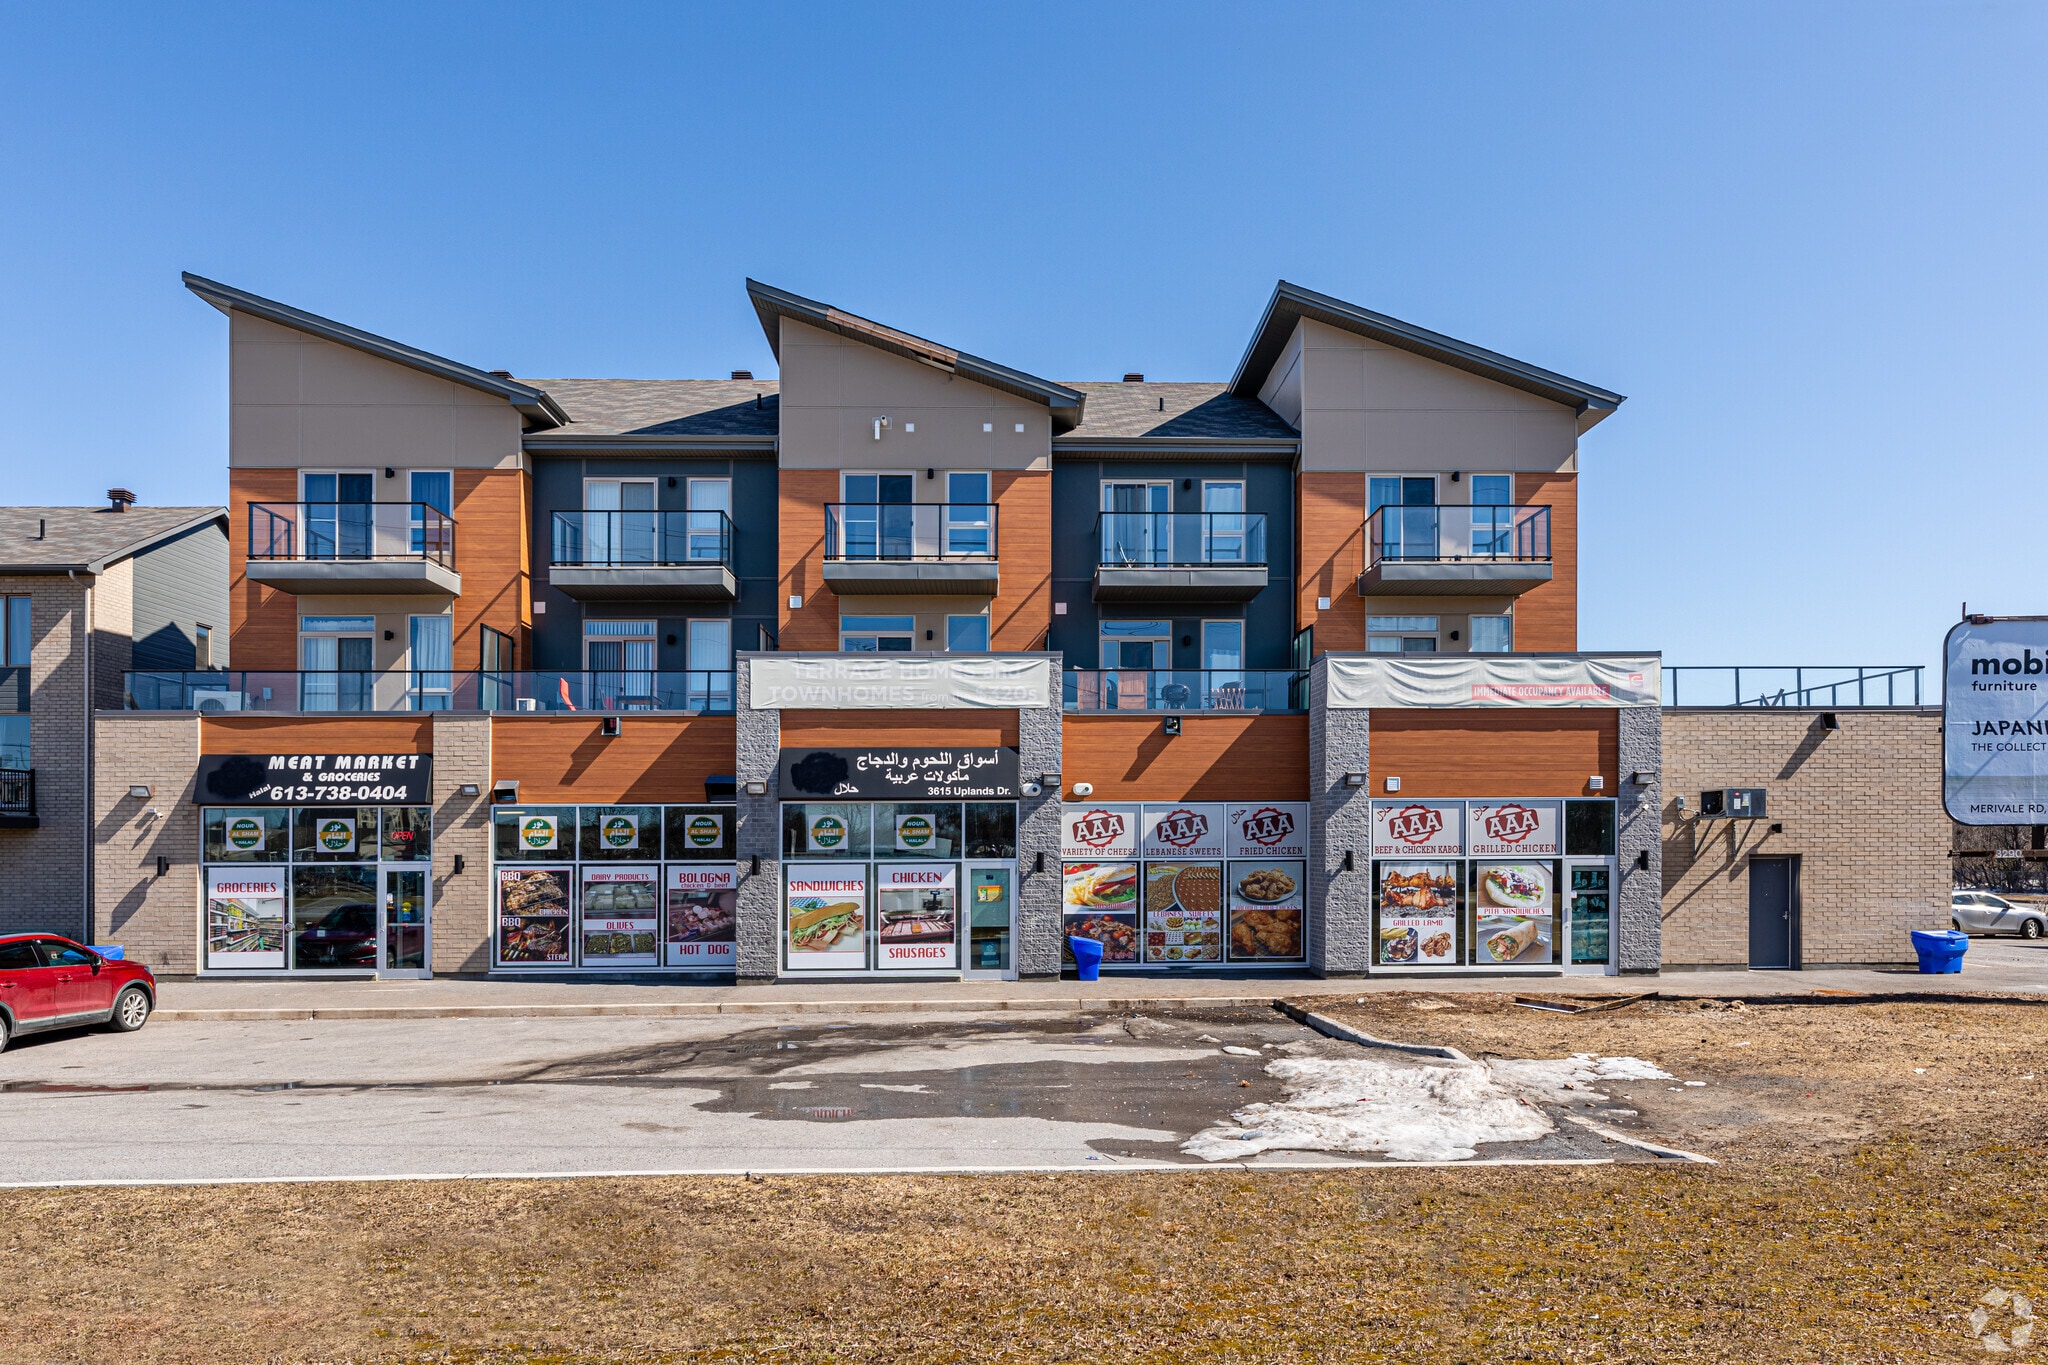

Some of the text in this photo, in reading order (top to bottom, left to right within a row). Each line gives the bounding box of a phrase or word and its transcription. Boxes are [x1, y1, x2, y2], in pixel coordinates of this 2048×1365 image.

[794, 664, 892, 680] TERRACE
[1474, 686, 1516, 697] IMMEDIATE
[1518, 686, 1564, 697] OCCUPANCY
[1566, 685, 1607, 697] AVAILABLE
[1972, 680, 2037, 692] furniture
[768, 685, 914, 702] TOWNHOMES
[921, 690, 951, 702] from
[1971, 742, 1993, 752] THE
[268, 755, 419, 770] MEAT MARKET
[857, 750, 999, 771] أسواق اللحوم والدجاج
[302, 772, 381, 782] & GROCERIES
[885, 767, 970, 785] مأكولات عربية
[249, 783, 271, 800] Halal
[270, 785, 408, 801] 613-738-0404
[834, 783, 859, 796] حلال
[928, 786, 1011, 798] 3615 Uplands Dr.
[1971, 804, 2048, 815] MERIVALE RD,
[1075, 815, 1124, 842] AAA
[1159, 815, 1208, 842] AAA
[1245, 813, 1294, 841] AAA
[1392, 811, 1441, 838] AAA
[1489, 810, 1538, 837] AAA
[390, 831, 415, 841] OPEN
[1062, 848, 1137, 856] VARIETY OF CHEESE
[1146, 847, 1221, 856] LEBANESE SWEETS
[1240, 846, 1303, 855] FRIED CHICKEN
[1374, 845, 1463, 854] BEEF & CHICKEN KABOB
[1473, 844, 1557, 853] GRILLED CHICKEN
[501, 871, 520, 881] BBQ
[679, 872, 730, 883] BOLOGNA
[892, 872, 942, 883] CHICKEN
[216, 881, 277, 893] GROCERIES
[789, 880, 864, 892] SANDWICHES
[1502, 907, 1545, 915] SANDWICHES
[502, 917, 521, 927] BBQ
[606, 921, 634, 929] OLIVES
[680, 944, 730, 955] HOT DOG
[889, 947, 946, 959] SAUSAGES
